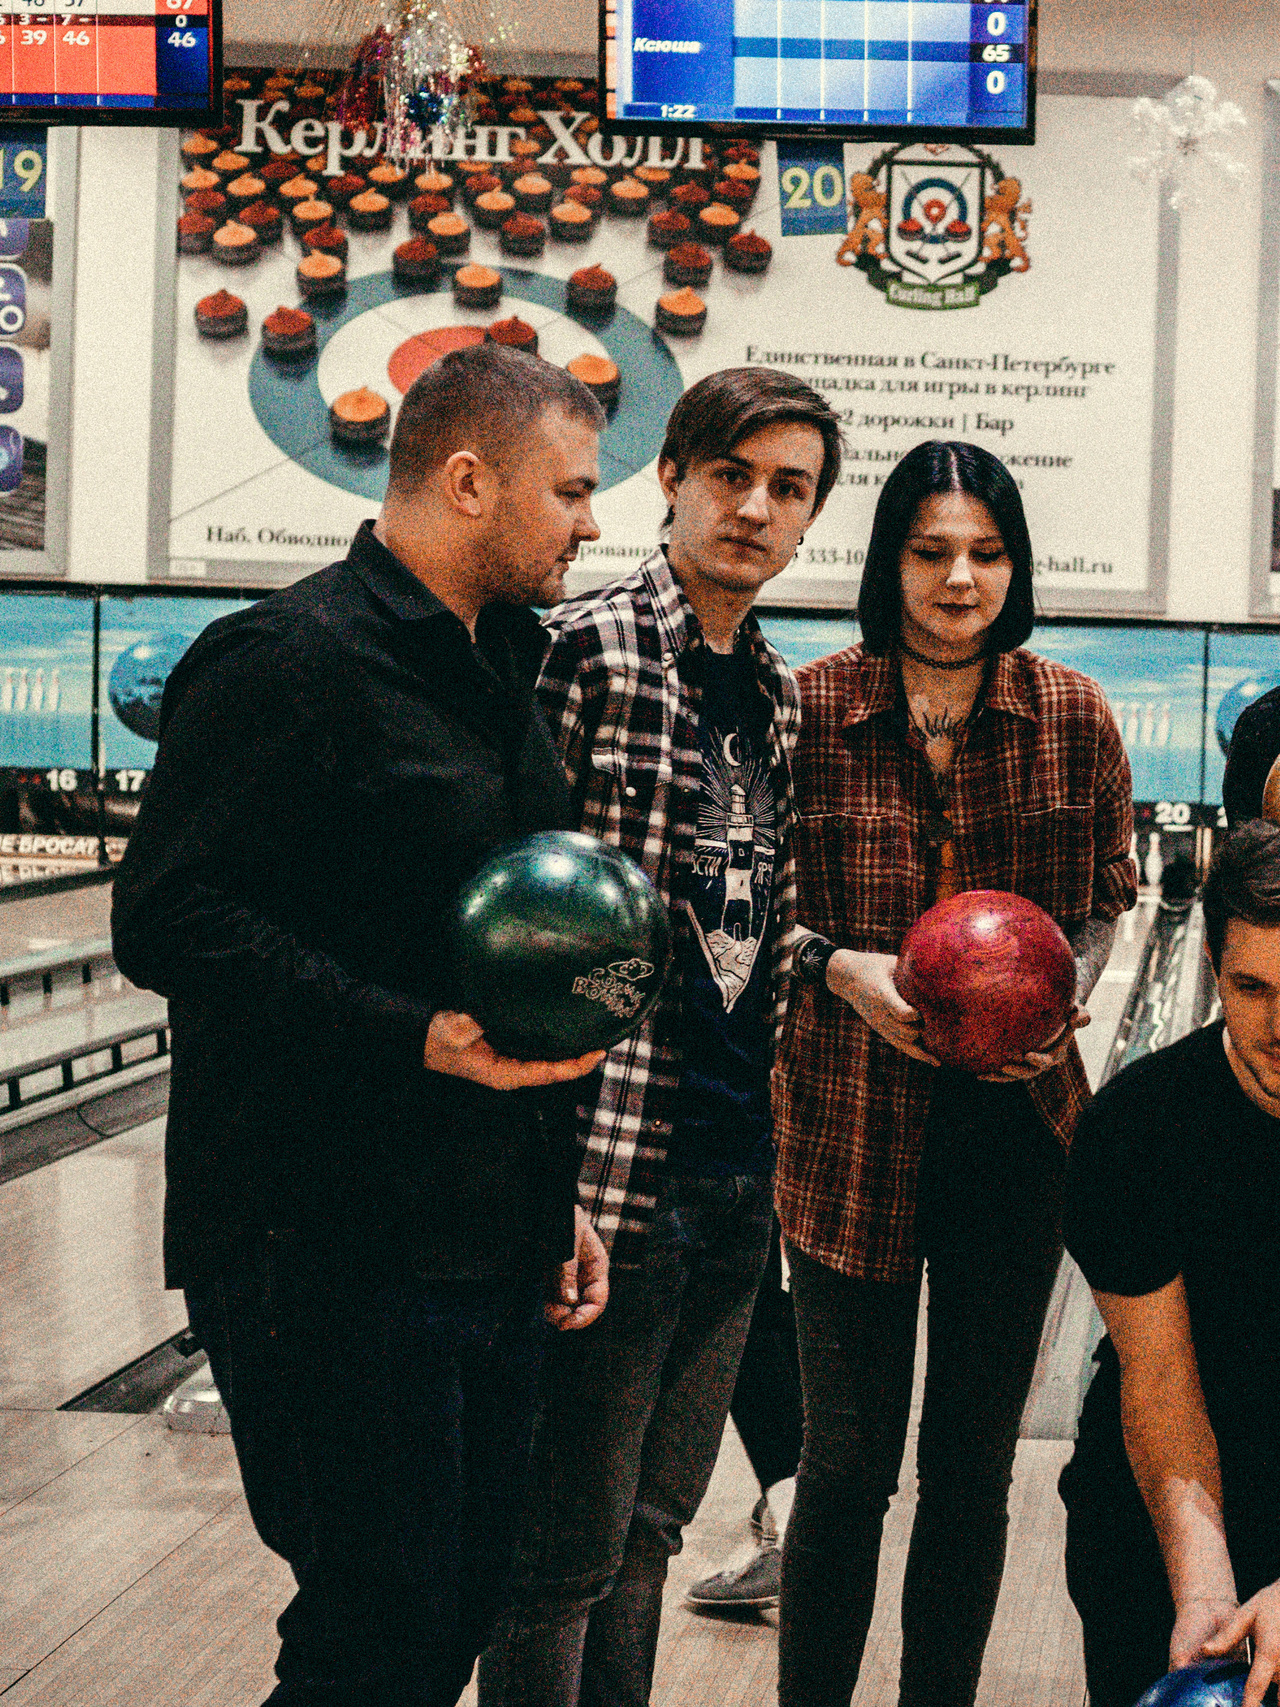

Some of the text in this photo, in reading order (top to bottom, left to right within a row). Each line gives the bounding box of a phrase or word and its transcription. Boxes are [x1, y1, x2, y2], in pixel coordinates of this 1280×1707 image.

[175, 14, 188, 28] 0
[986, 11, 1007, 38] 0
[20, 29, 48, 46] 39
[62, 30, 91, 46] 46
[167, 31, 197, 48] 46
[633, 37, 1012, 63] Ксюша 65
[985, 70, 1007, 95] 0
[660, 104, 696, 118] 1:22
[780, 163, 845, 209] 20
[745, 344, 899, 370] Единственная
[920, 351, 1116, 378] Санкт-Петербурге
[924, 381, 980, 401] игры
[1001, 384, 1091, 404] керлинг
[859, 413, 955, 433] дорожки
[975, 412, 1015, 436] Бар
[206, 525, 252, 545] Наб.
[257, 527, 352, 548] Обводно
[805, 549, 865, 565] 333-10
[46, 768, 147, 792] 16 17
[1154, 801, 1192, 825] 20
[19, 836, 99, 856] БРОСАТ
